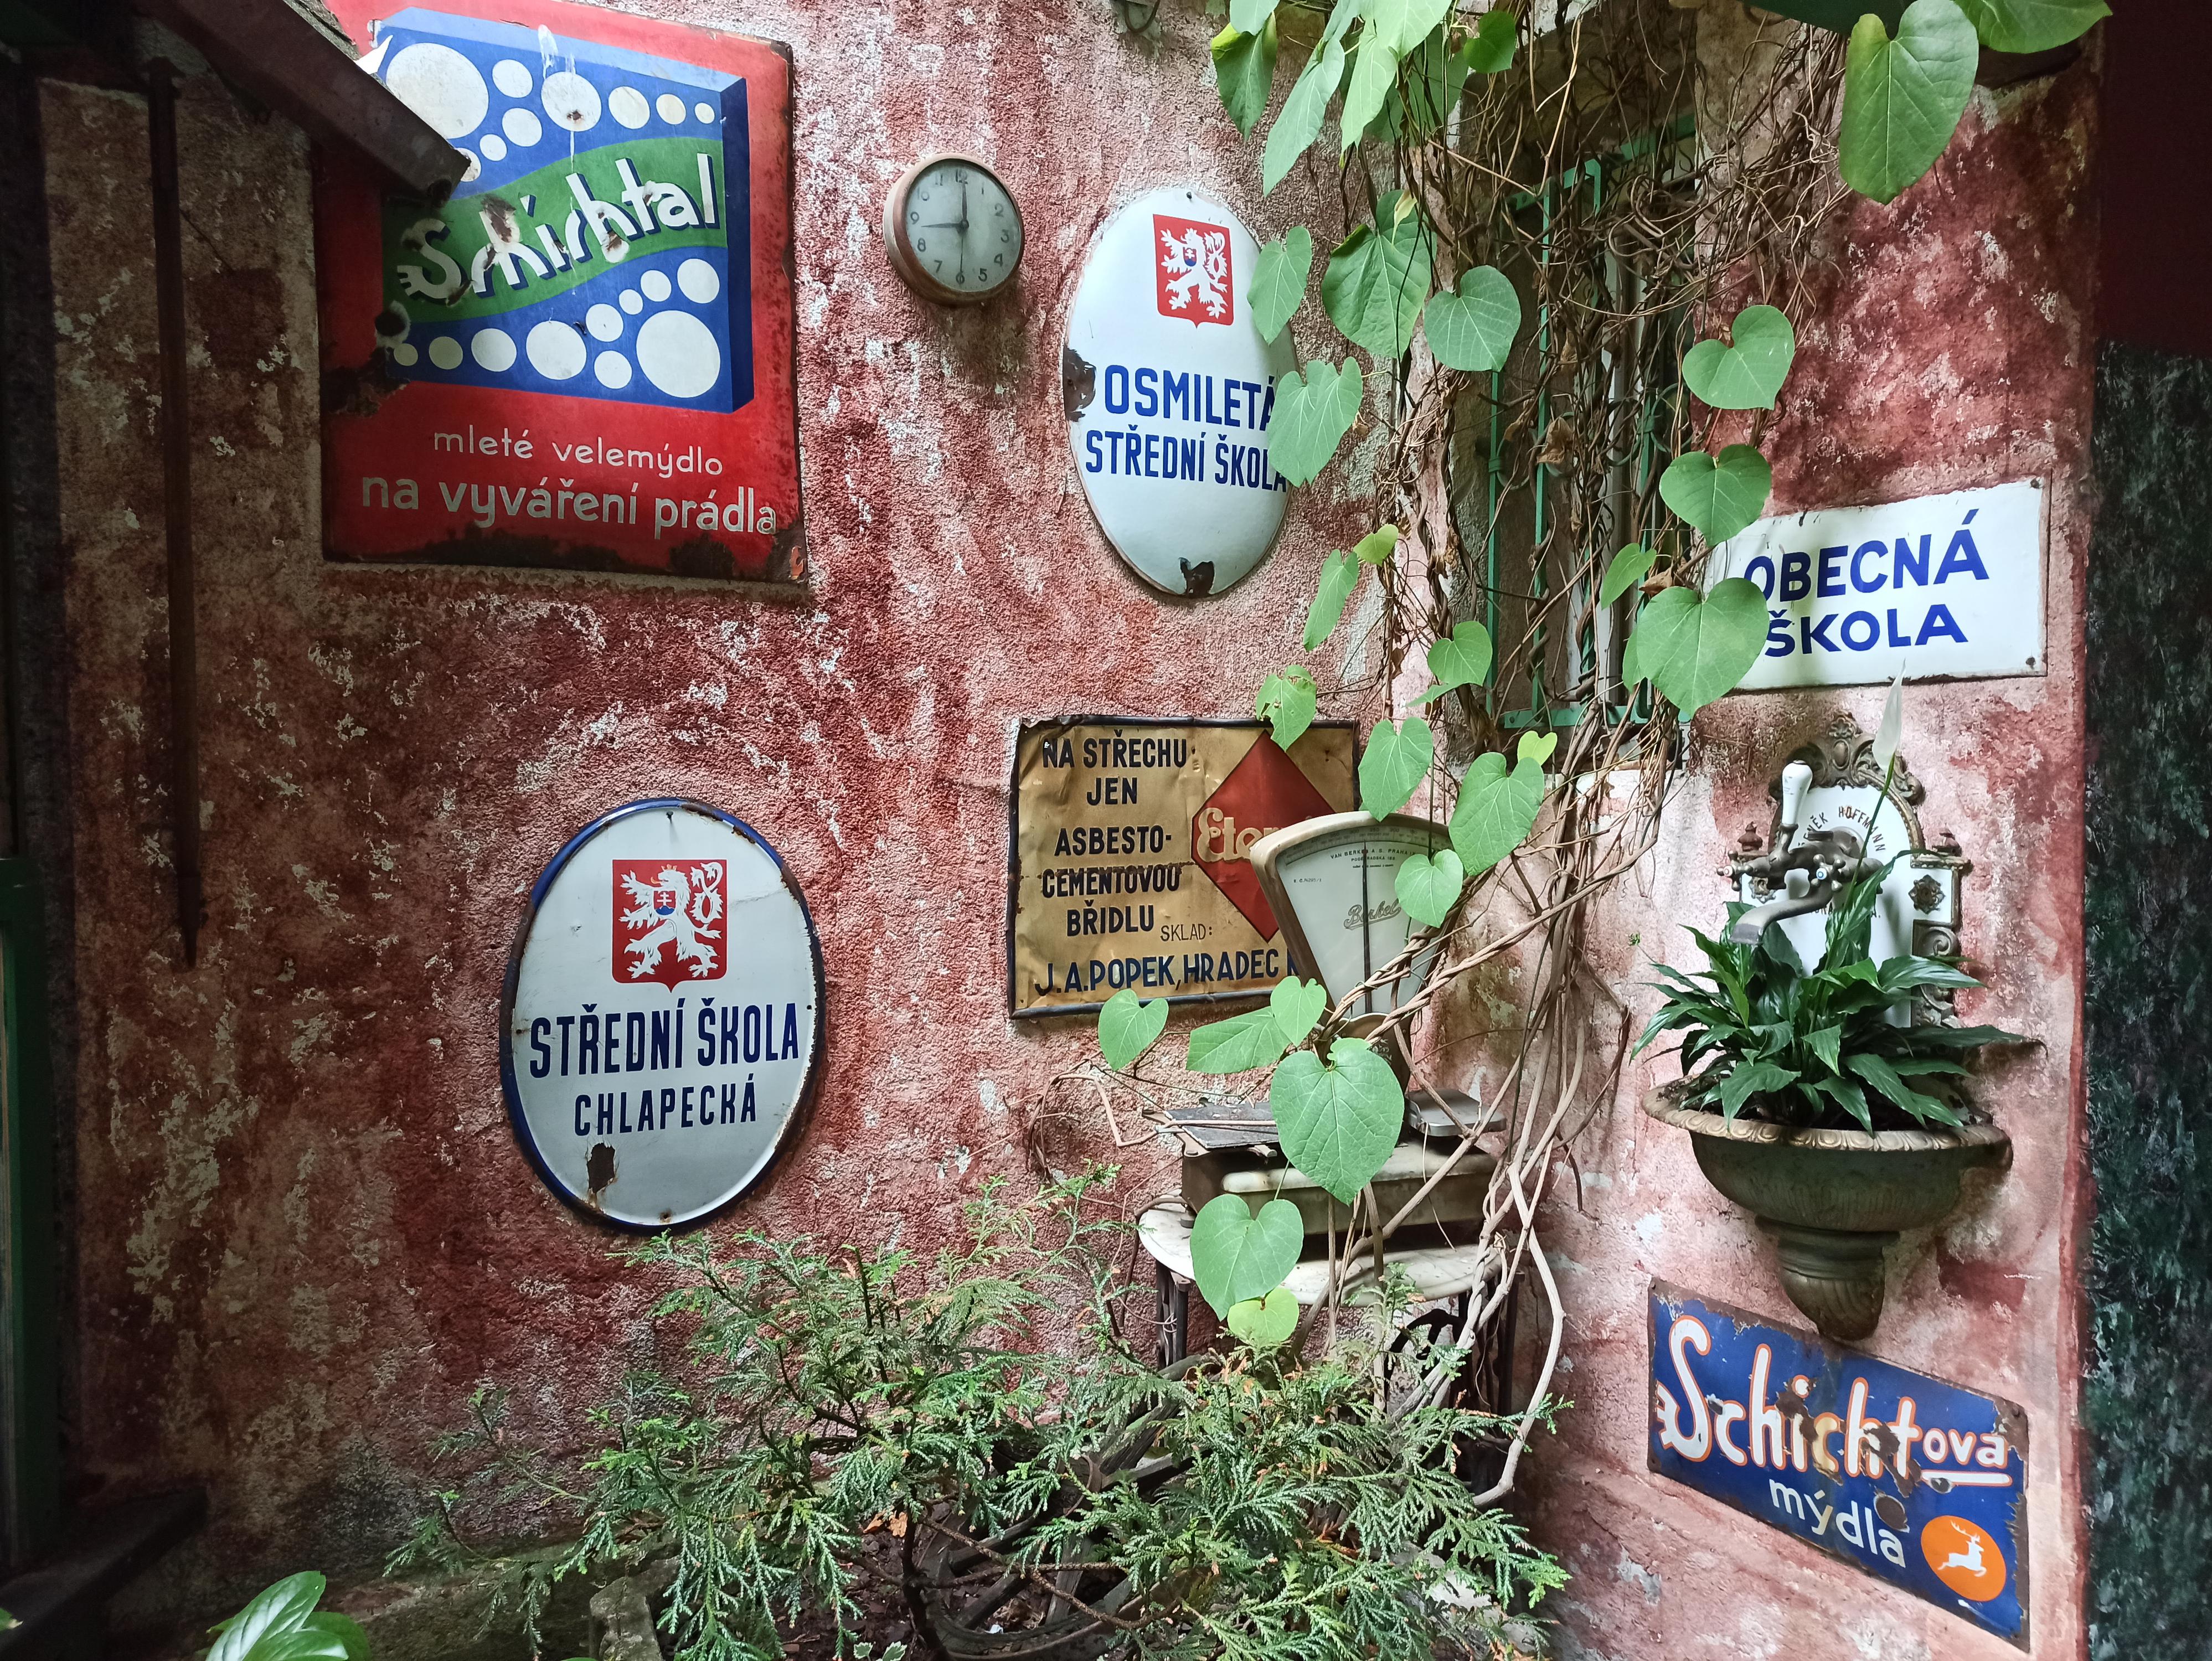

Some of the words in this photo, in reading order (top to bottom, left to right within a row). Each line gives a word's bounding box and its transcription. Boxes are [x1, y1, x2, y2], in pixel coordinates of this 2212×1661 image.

[910, 211, 920, 225] 9
[994, 203, 1004, 217] 2
[916, 238, 926, 252] 8
[1000, 229, 1010, 243] 3
[934, 260, 942, 273] 7
[978, 268, 988, 282] 5
[993, 253, 1003, 267] 4
[955, 271, 965, 284] 6
[434, 424, 534, 460] mleté
[551, 436, 724, 478] velemýdlo
[1085, 424, 1206, 482] STŘEDNÍ
[362, 476, 420, 511] na
[439, 476, 638, 529] vyváření
[654, 486, 776, 540] prádla
[1743, 508, 1989, 603] OBECNÁ
[1764, 603, 1968, 658] ŠKOLA
[1042, 738, 1074, 768] NA
[1083, 729, 1187, 768] STŘECHU
[1086, 776, 1137, 806] JEN
[1054, 824, 1172, 857] ASBESTO-
[1041, 864, 1180, 899] CEMENTOVOU
[1066, 899, 1154, 937] BŘIDLU
[1343, 897, 1402, 931] Brkel
[1160, 923, 1213, 942] SKLAD:
[529, 997, 685, 1079] STŘEDNÍ
[697, 997, 800, 1067] ŠKOLA
[574, 1072, 757, 1137] CHLAPECKÁ
[1769, 1478, 1906, 1569] mýdla
